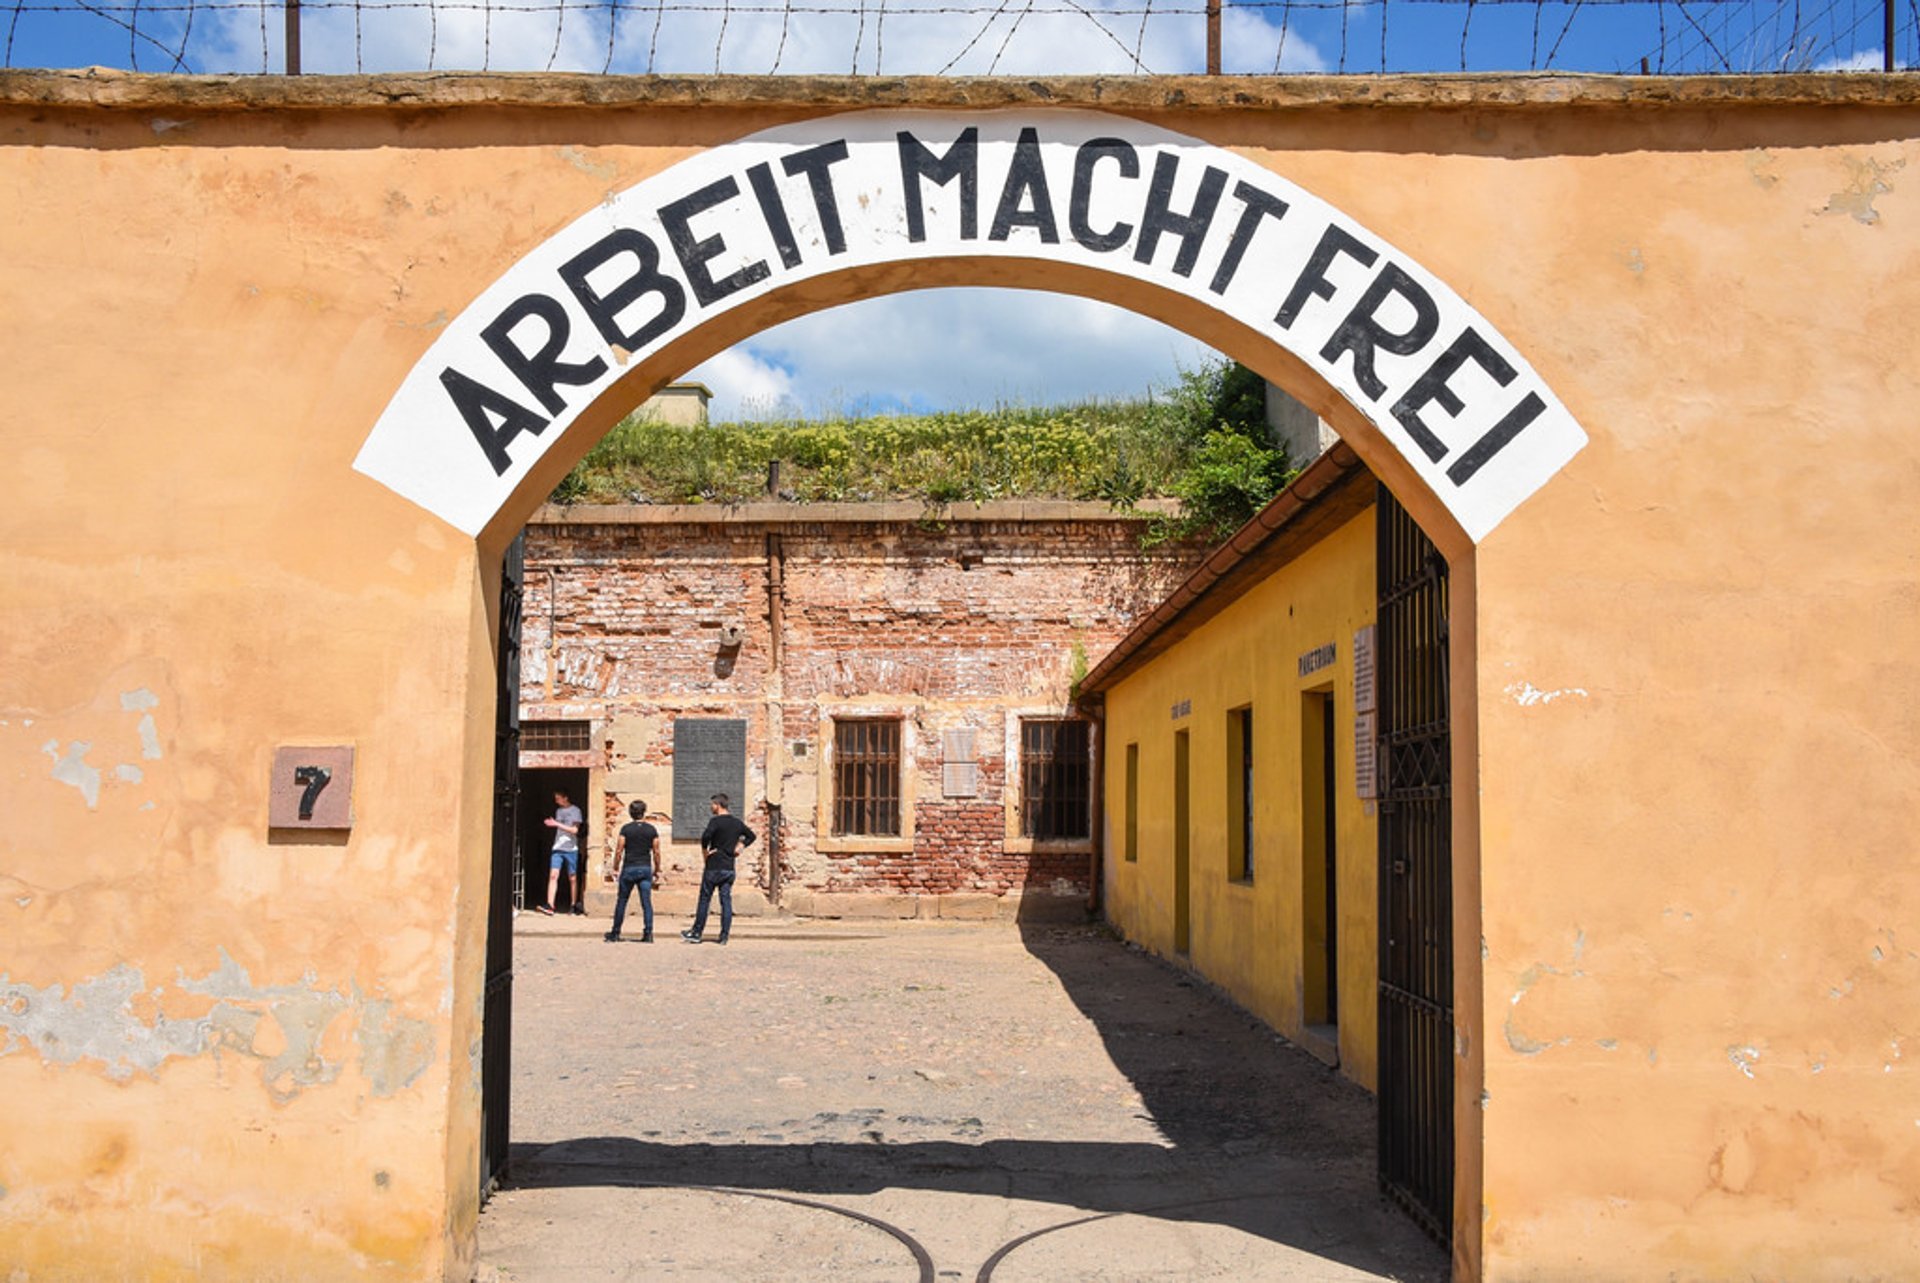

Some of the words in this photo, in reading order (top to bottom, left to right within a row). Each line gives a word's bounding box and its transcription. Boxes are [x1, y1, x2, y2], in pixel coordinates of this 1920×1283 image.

[439, 139, 849, 477] ARBEIT
[897, 127, 1289, 296] MACHT
[1273, 223, 1547, 487] FREI
[295, 766, 332, 820] 7
